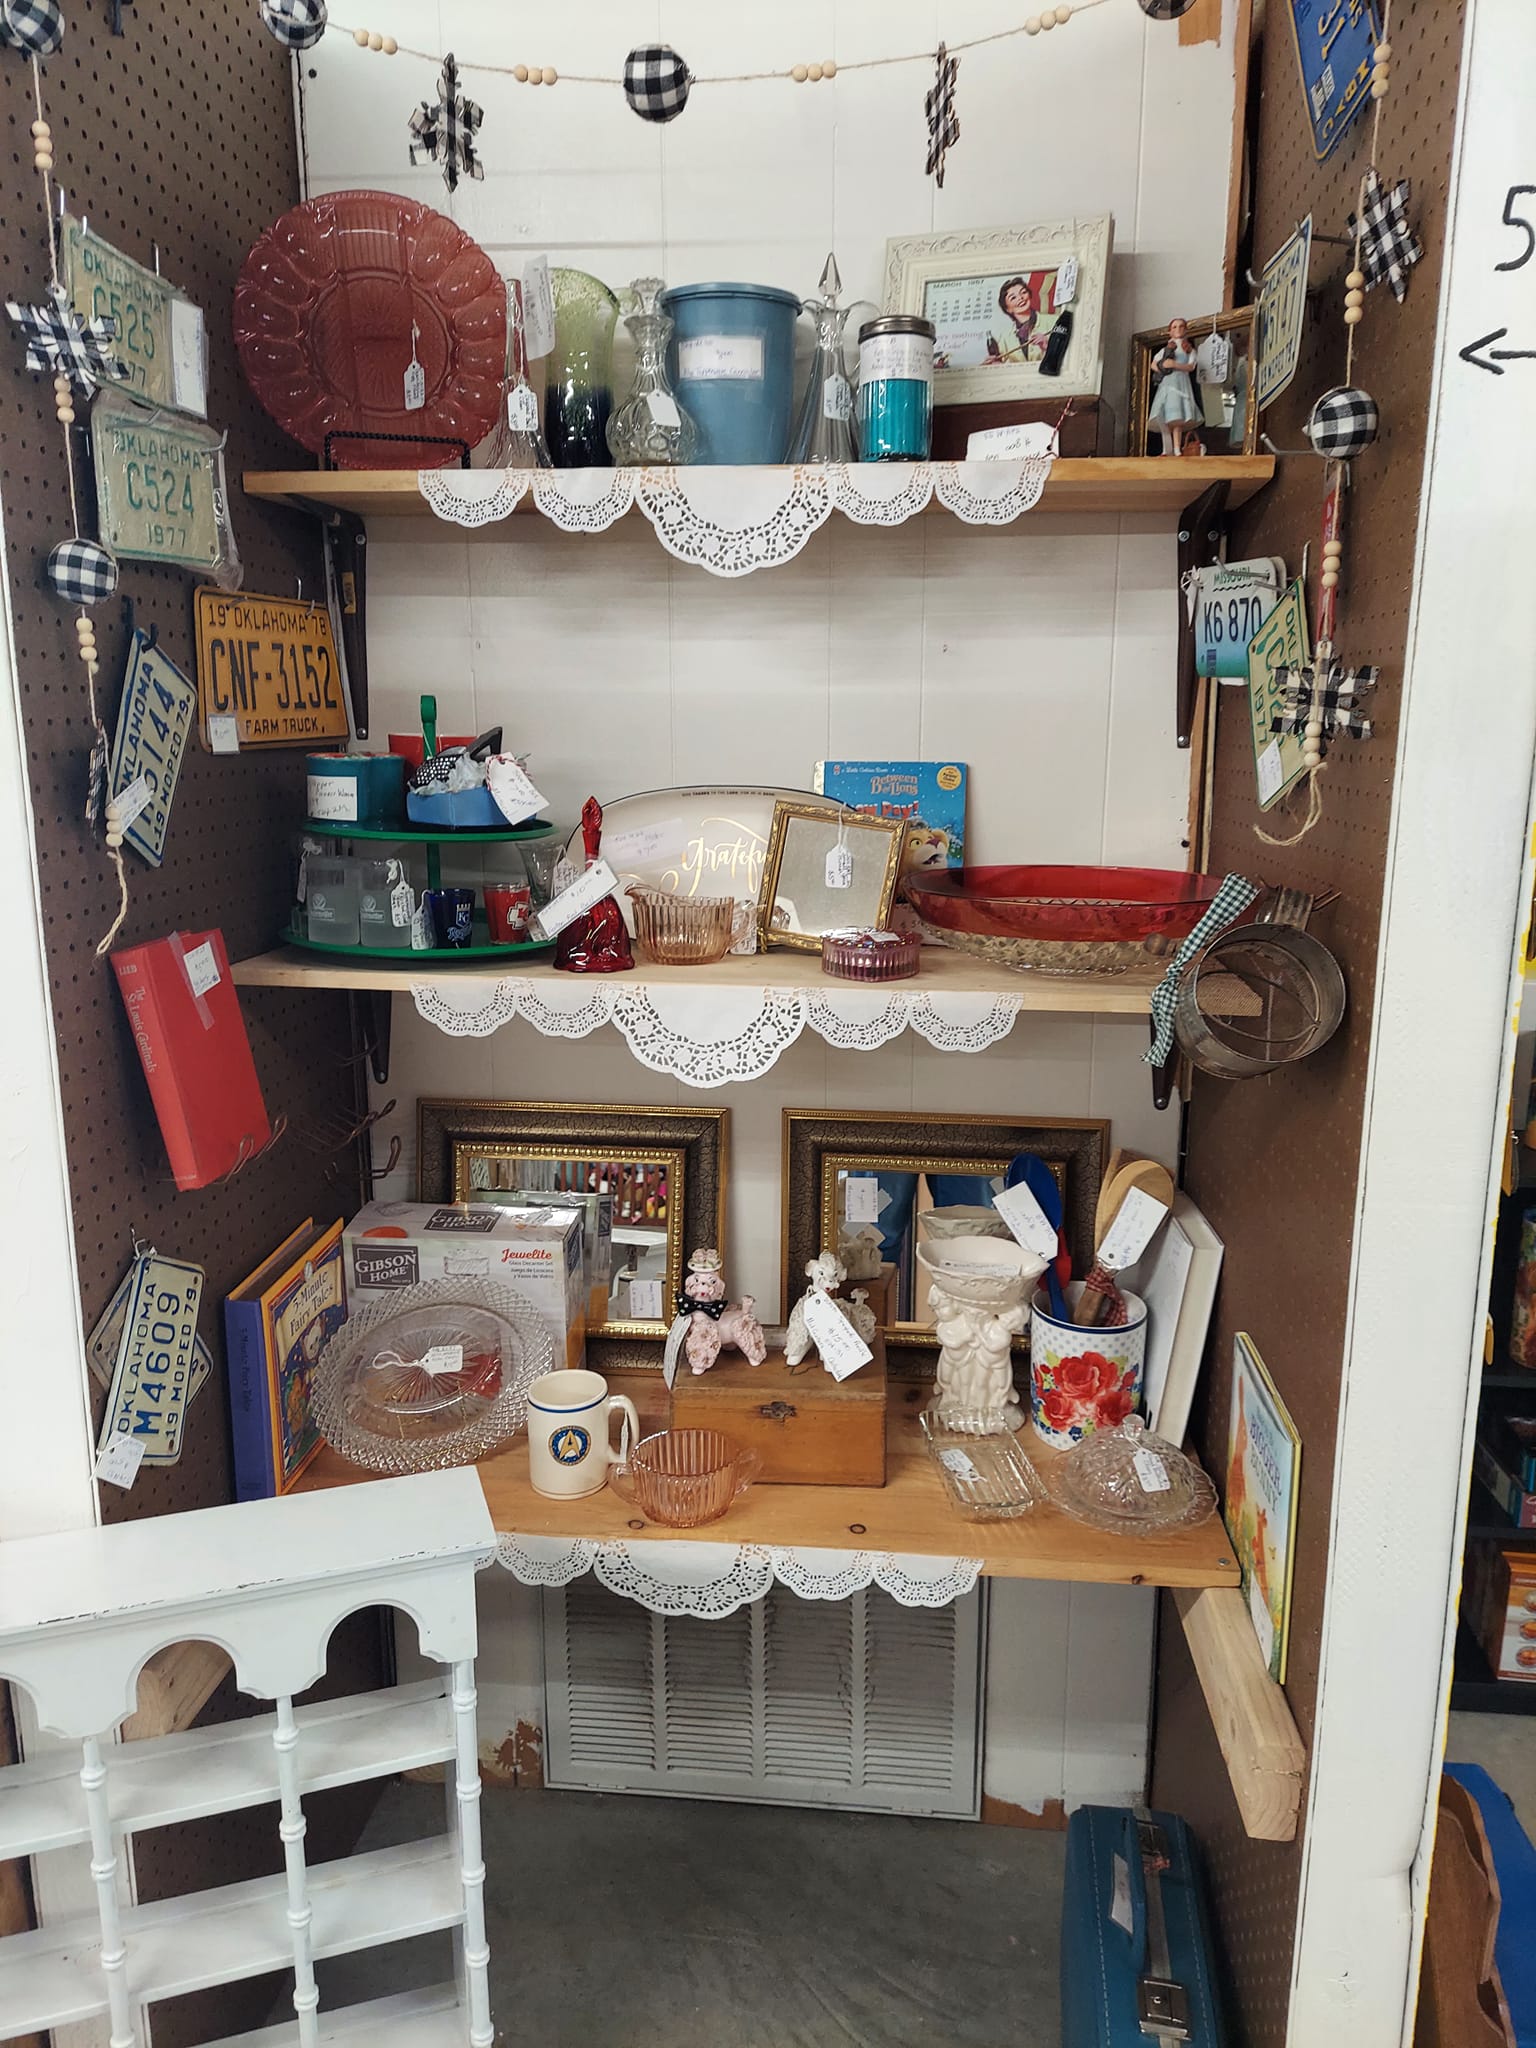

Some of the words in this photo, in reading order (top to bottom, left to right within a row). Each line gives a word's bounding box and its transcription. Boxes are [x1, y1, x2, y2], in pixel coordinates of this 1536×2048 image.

[93, 286, 155, 360] C525
[117, 433, 202, 469] OKLAHOMA
[126, 461, 195, 519] C524
[148, 526, 186, 548] 1977
[208, 604, 227, 626] 19
[234, 607, 307, 633] OKLAHOMA
[210, 638, 338, 711] CNF-3152
[245, 720, 279, 736] FARM
[282, 717, 318, 734] TRUCK
[140, 678, 175, 825] 5144
[154, 811, 164, 838] 19
[160, 732, 182, 806] MOPED
[176, 699, 190, 727] 79
[870, 774, 918, 795] Between
[135, 1032, 157, 1073] Cardinals
[355, 1254, 417, 1273] GIBSON
[501, 1248, 552, 1262] Jewelite
[370, 1267, 407, 1282] HOME
[184, 1288, 197, 1315] 79
[118, 1283, 156, 1433] OKLAHOMA
[132, 1292, 180, 1434] M4609
[171, 1324, 192, 1402] MOPED
[166, 1412, 179, 1438] 19
